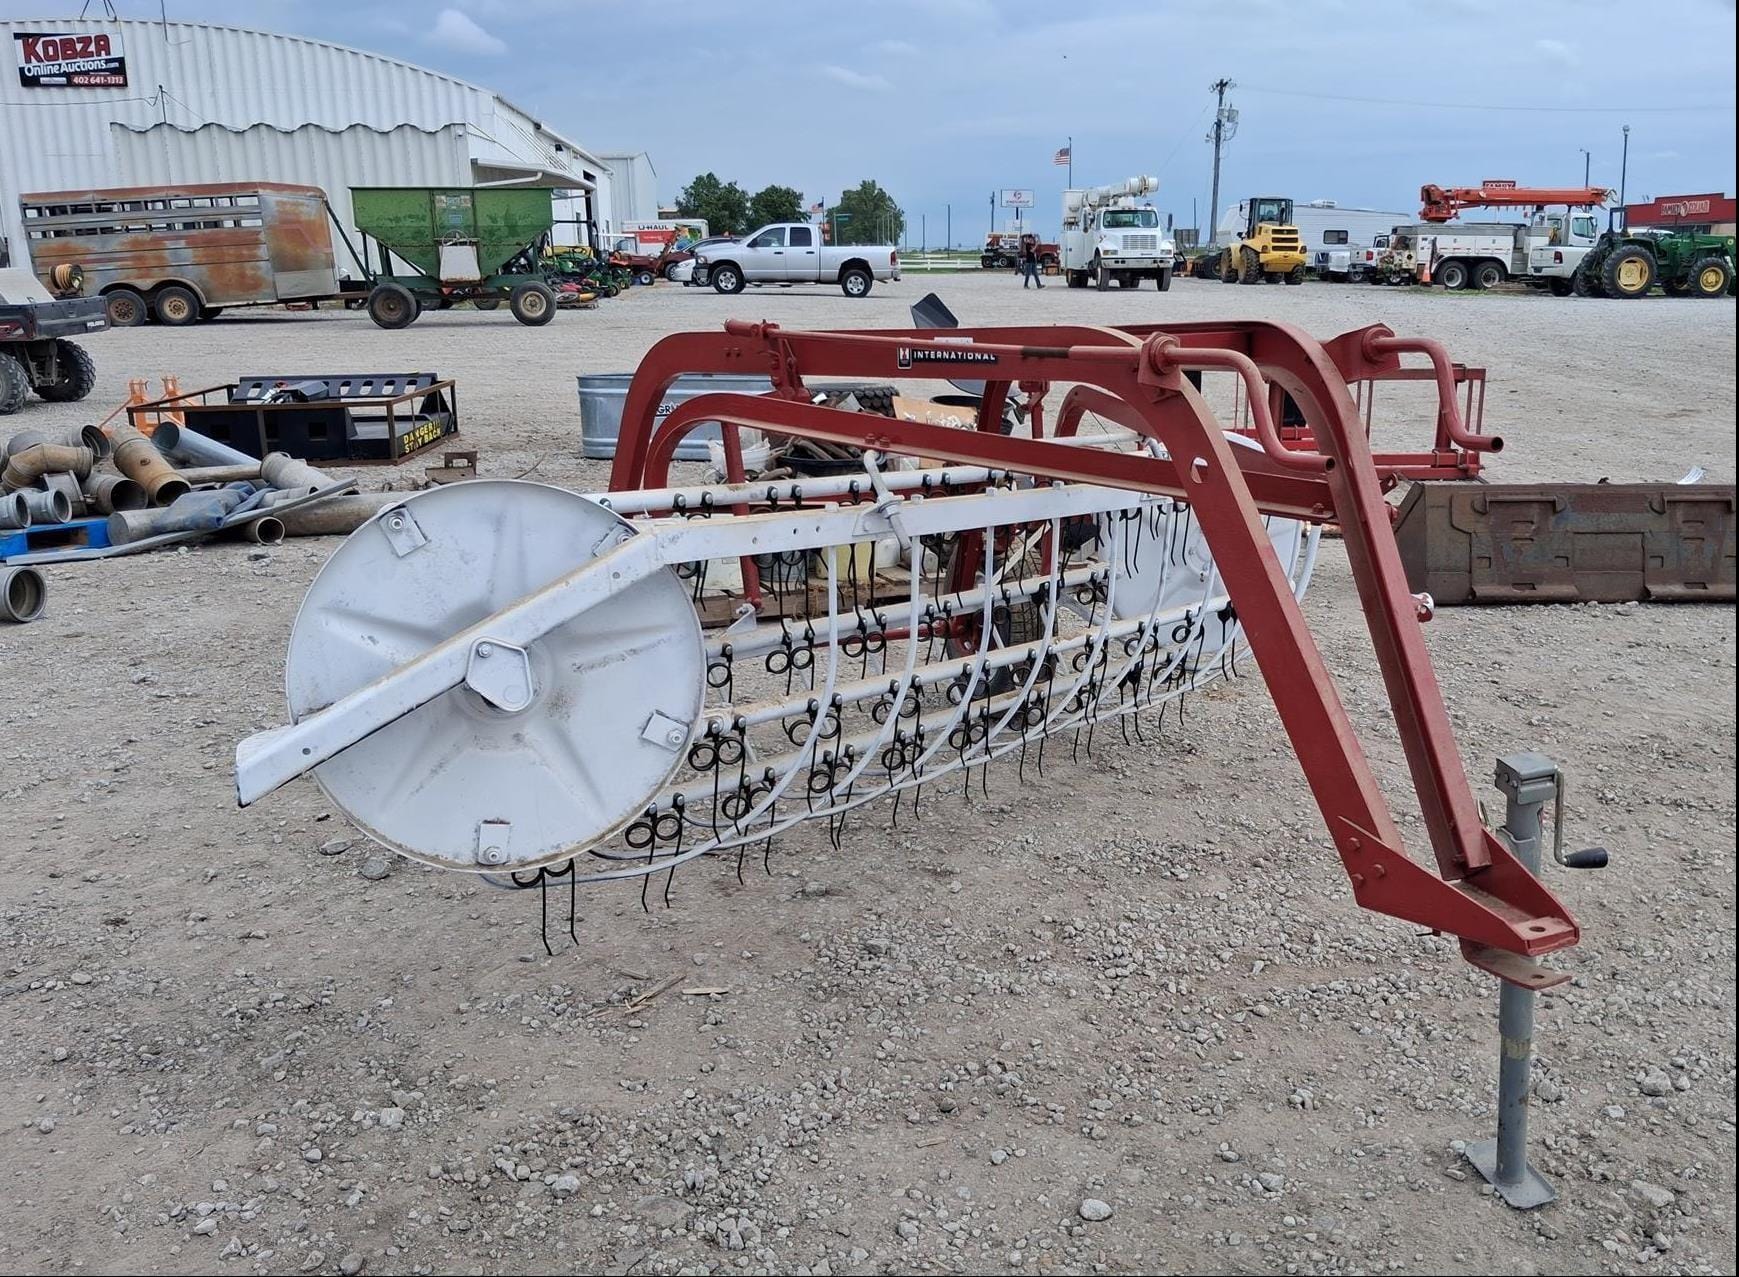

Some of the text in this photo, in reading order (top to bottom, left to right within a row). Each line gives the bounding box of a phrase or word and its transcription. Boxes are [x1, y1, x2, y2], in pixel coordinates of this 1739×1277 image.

[21, 34, 112, 64] KOBZA
[73, 76, 89, 85] 402
[913, 350, 997, 361] INTERNATIONAL
[405, 427, 441, 454] STAY BACK
